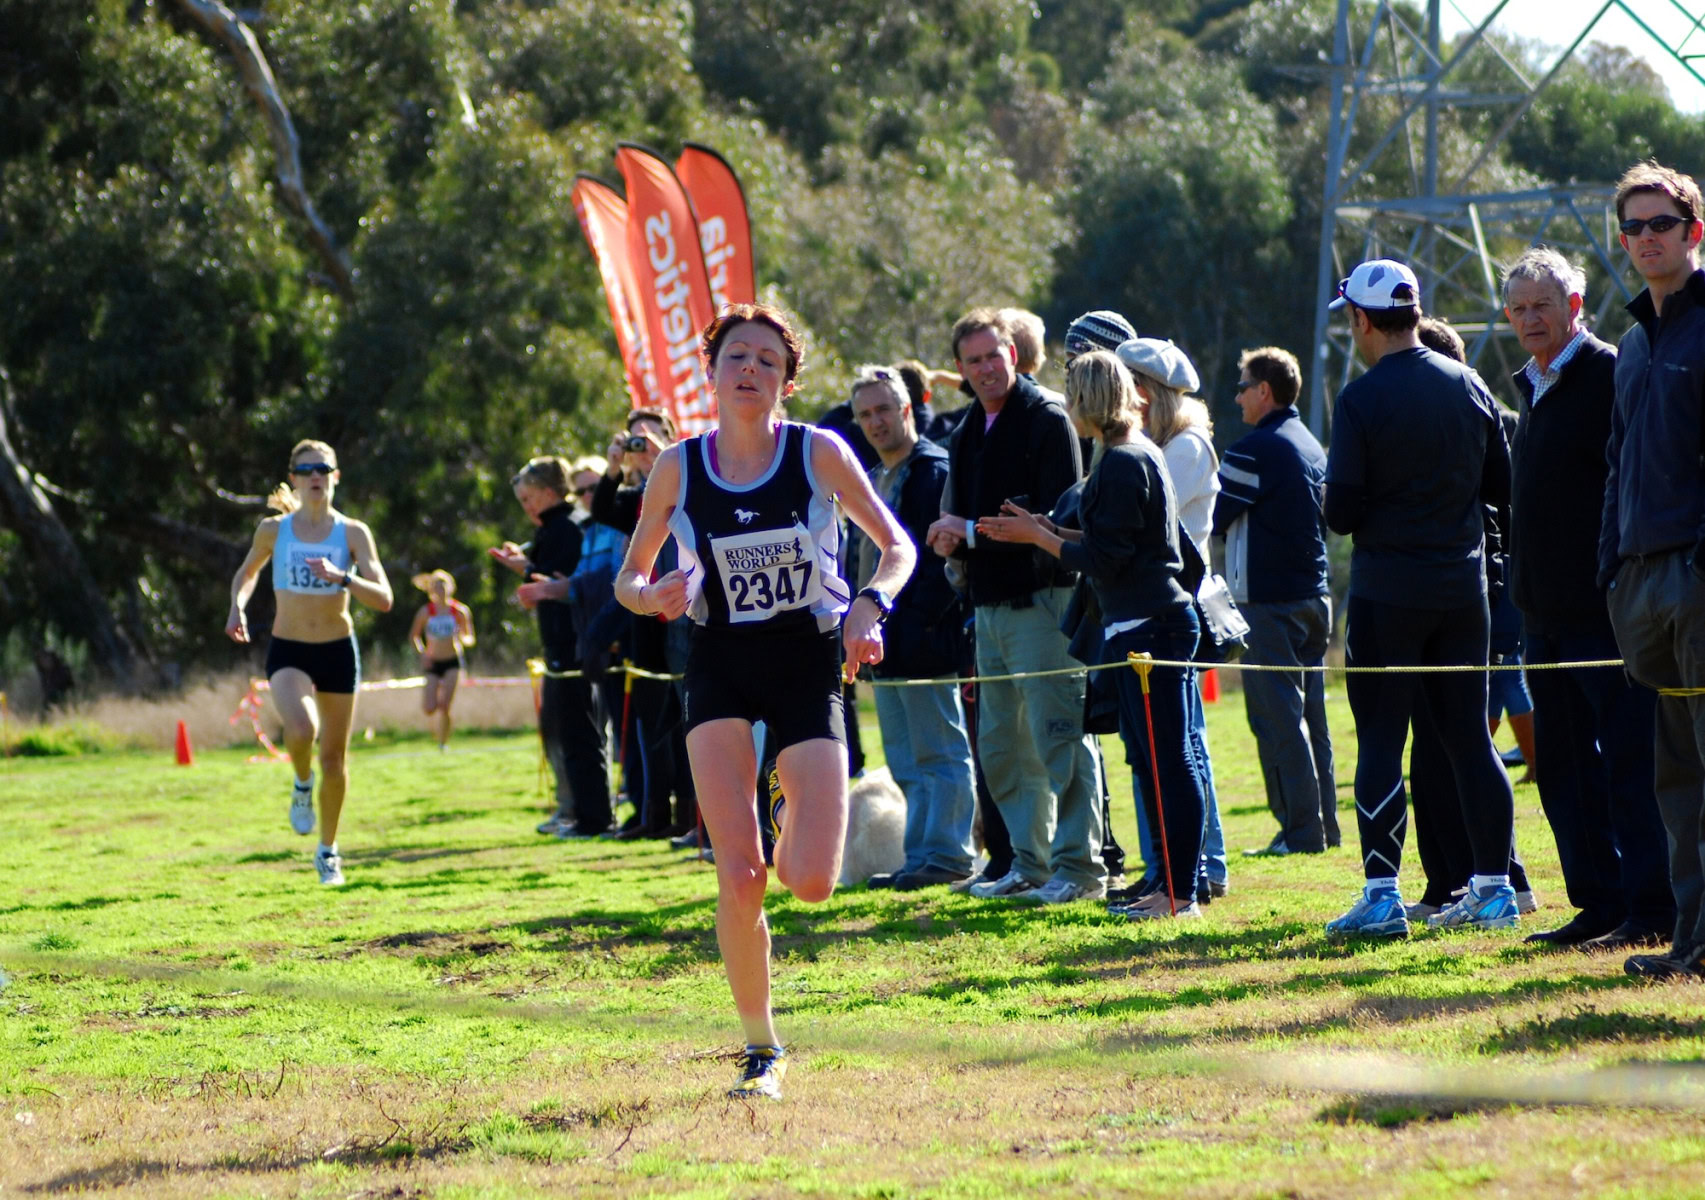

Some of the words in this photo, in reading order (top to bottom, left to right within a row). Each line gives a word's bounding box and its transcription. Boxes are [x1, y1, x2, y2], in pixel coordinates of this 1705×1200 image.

[725, 543, 791, 560] RUNNERS
[728, 556, 780, 570] WORLD
[290, 565, 333, 588] 132
[729, 560, 813, 612] 2347
